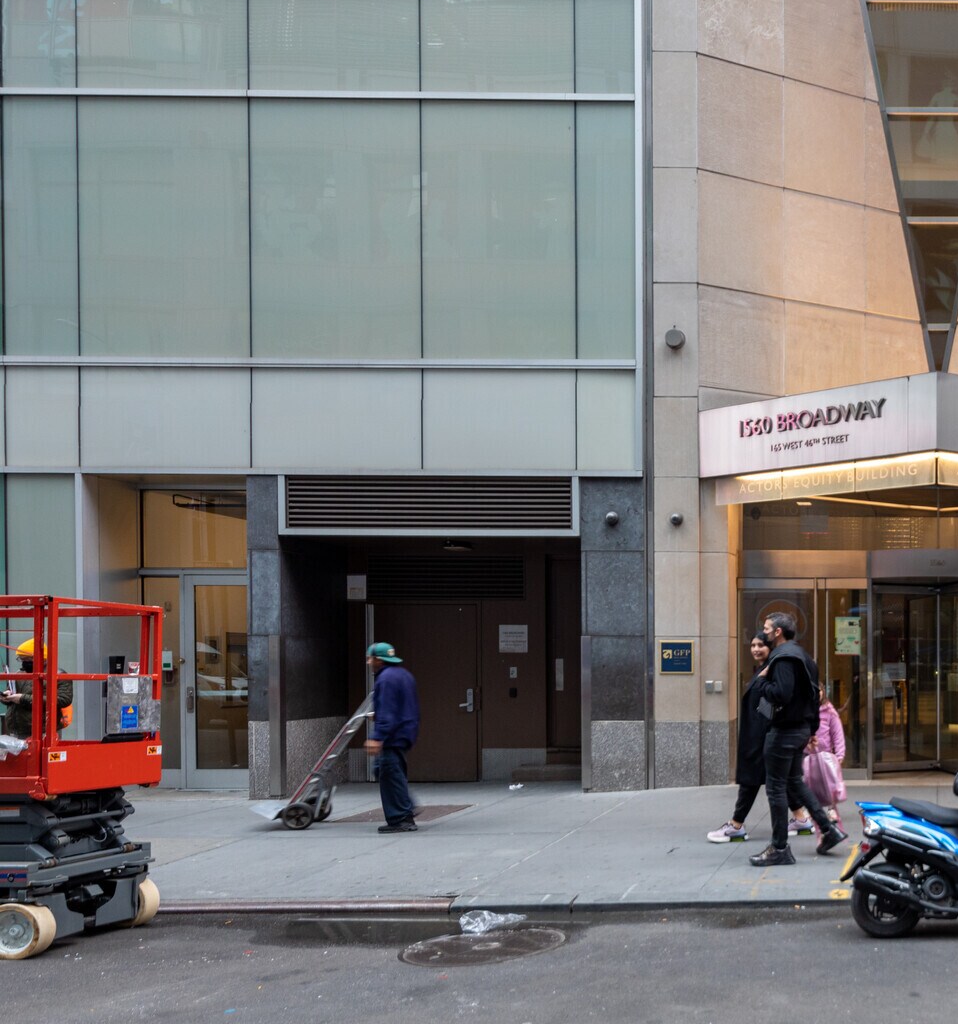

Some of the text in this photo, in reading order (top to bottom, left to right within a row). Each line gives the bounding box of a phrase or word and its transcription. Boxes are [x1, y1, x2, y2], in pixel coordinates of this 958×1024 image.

[738, 397, 887, 438] 1560 BROADWAY
[770, 434, 850, 452] 165 WEST 46TH STREET
[793, 472, 844, 489] EQUITY
[847, 463, 918, 483] BUILDING
